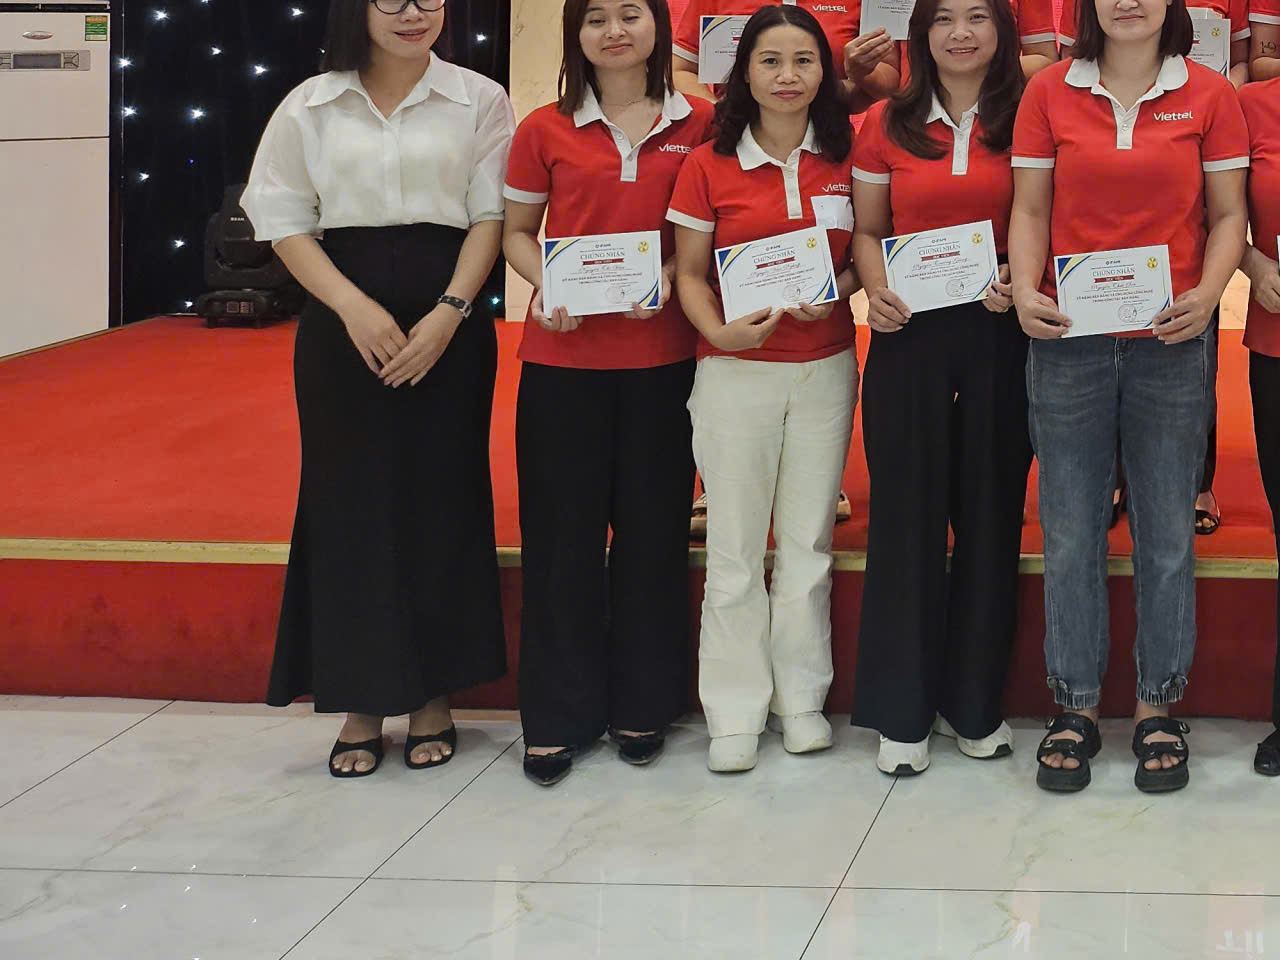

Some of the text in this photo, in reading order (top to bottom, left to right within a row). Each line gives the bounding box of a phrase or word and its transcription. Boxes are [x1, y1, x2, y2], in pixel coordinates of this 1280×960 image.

[812, 3, 848, 13] viettel
[1153, 111, 1193, 122] viettel
[658, 143, 692, 154] viette
